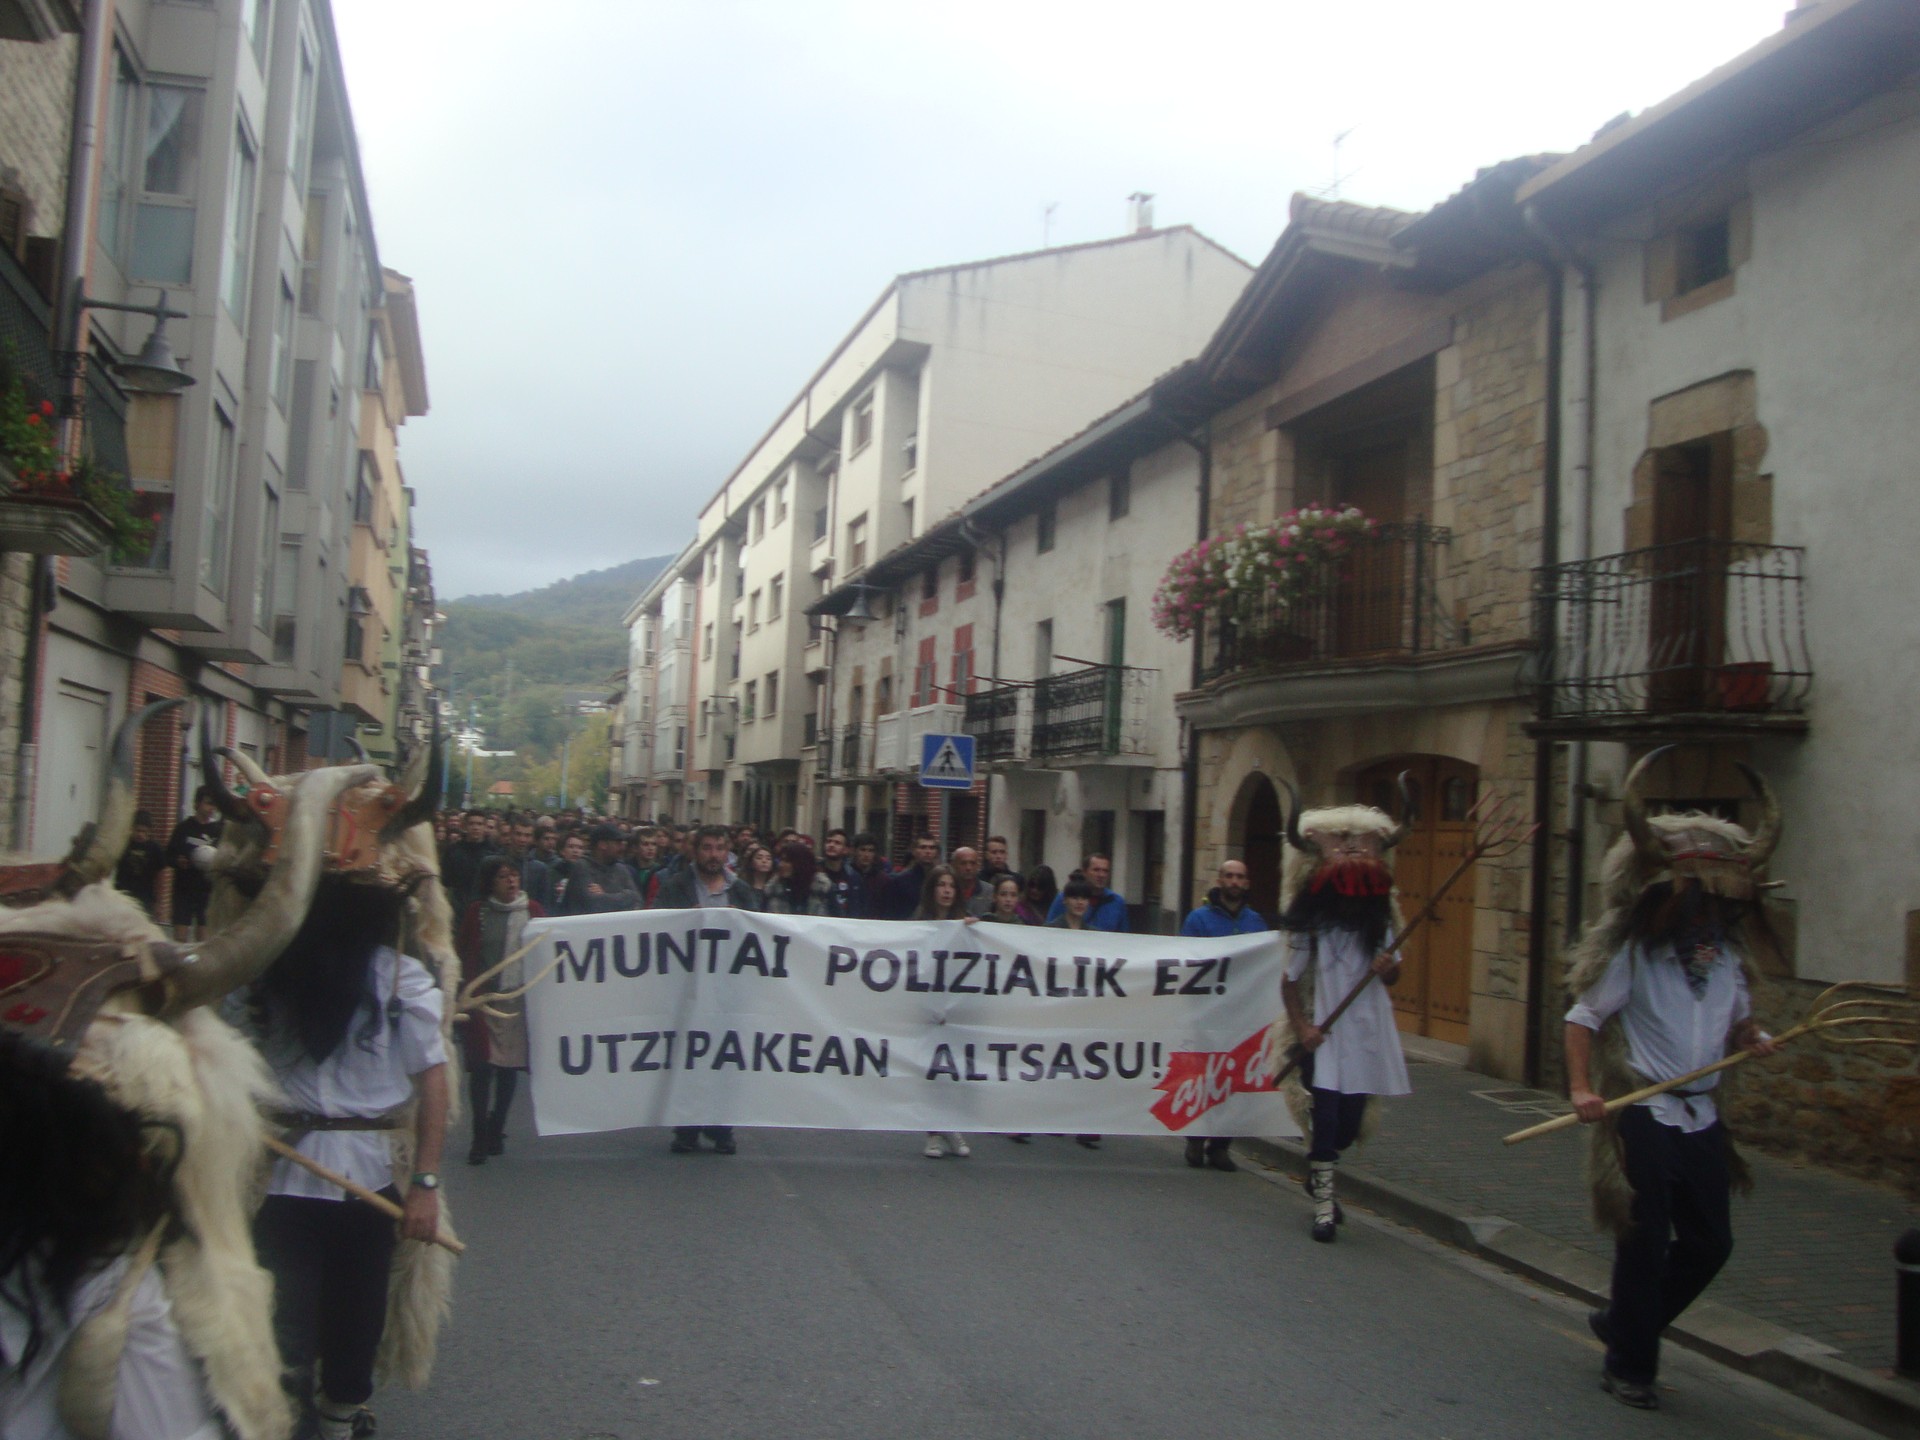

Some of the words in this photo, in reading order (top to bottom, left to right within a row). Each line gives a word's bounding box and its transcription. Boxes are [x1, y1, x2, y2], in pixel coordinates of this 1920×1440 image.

[554, 928, 791, 984] MUNTAI
[825, 944, 1128, 998] POLIZIALIK
[1152, 957, 1232, 997] EZ!
[559, 1030, 677, 1076] UTZI
[684, 1030, 889, 1078] PAKEAN
[926, 1041, 1162, 1082] ALTSASU!
